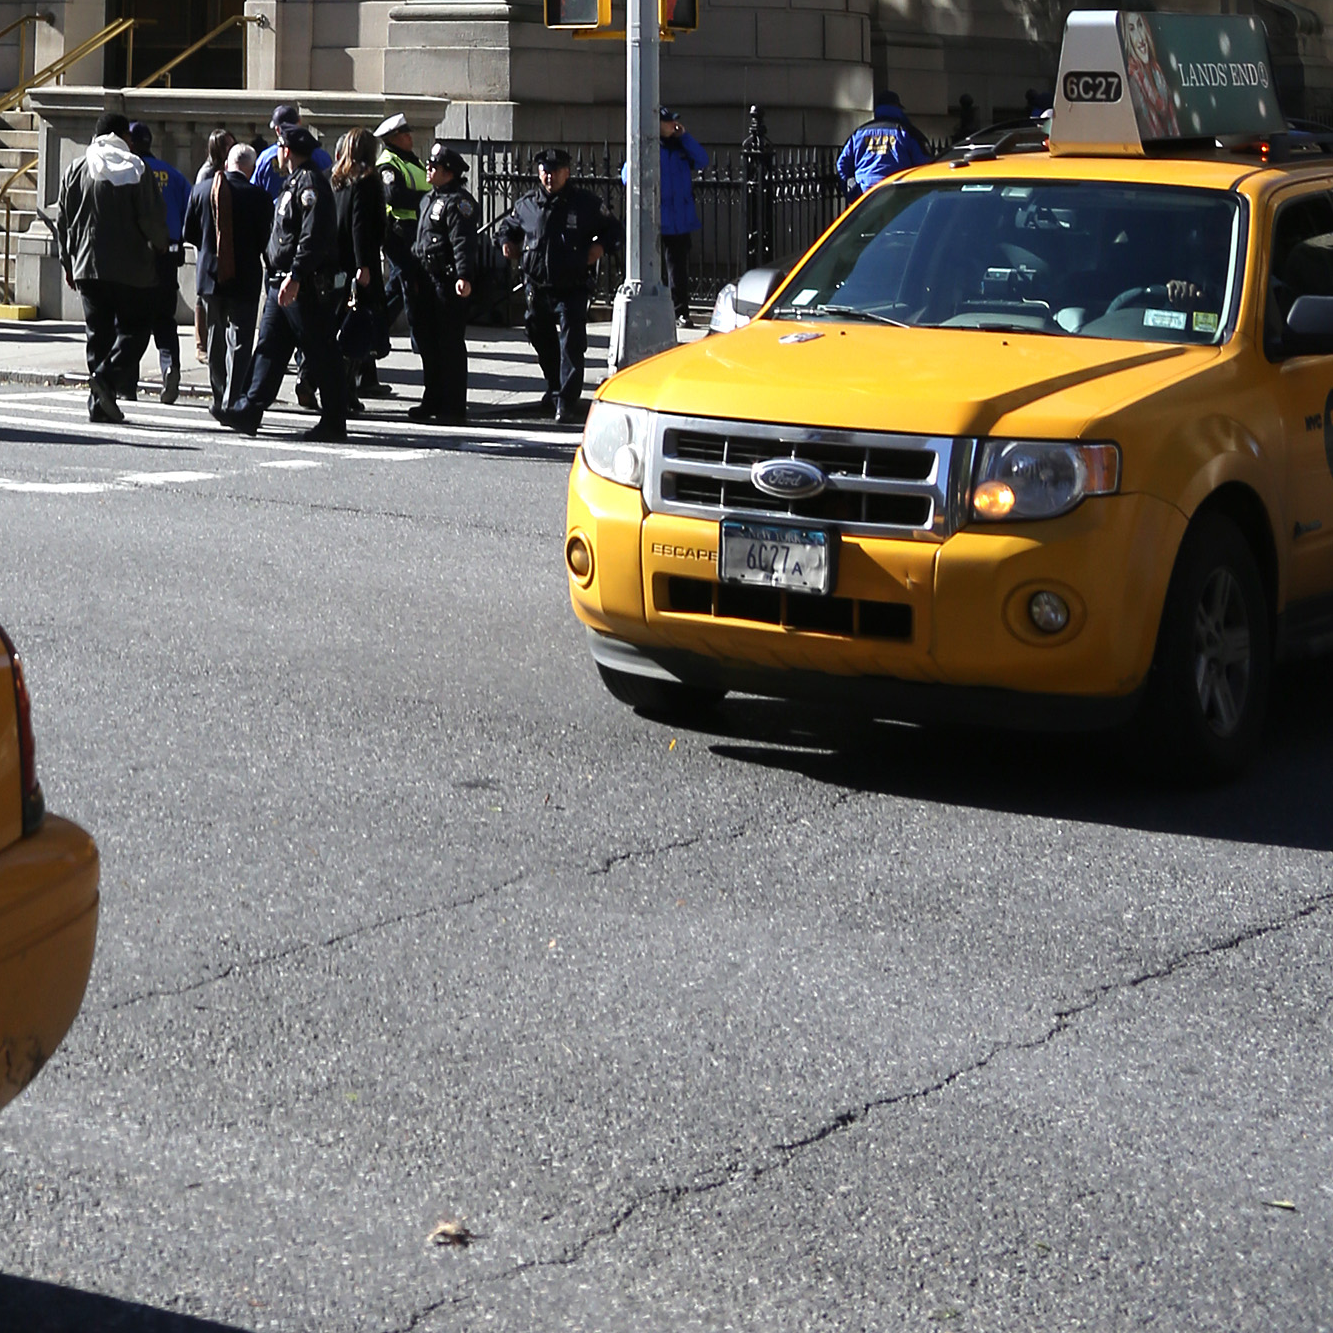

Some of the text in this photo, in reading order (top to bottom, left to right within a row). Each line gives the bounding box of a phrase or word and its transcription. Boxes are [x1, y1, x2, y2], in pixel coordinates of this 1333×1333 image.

[1178, 62, 1258, 87] LANDS' END
[1066, 76, 1119, 100] 6C27
[768, 468, 803, 487] Ford
[652, 541, 719, 563] ESCAPE
